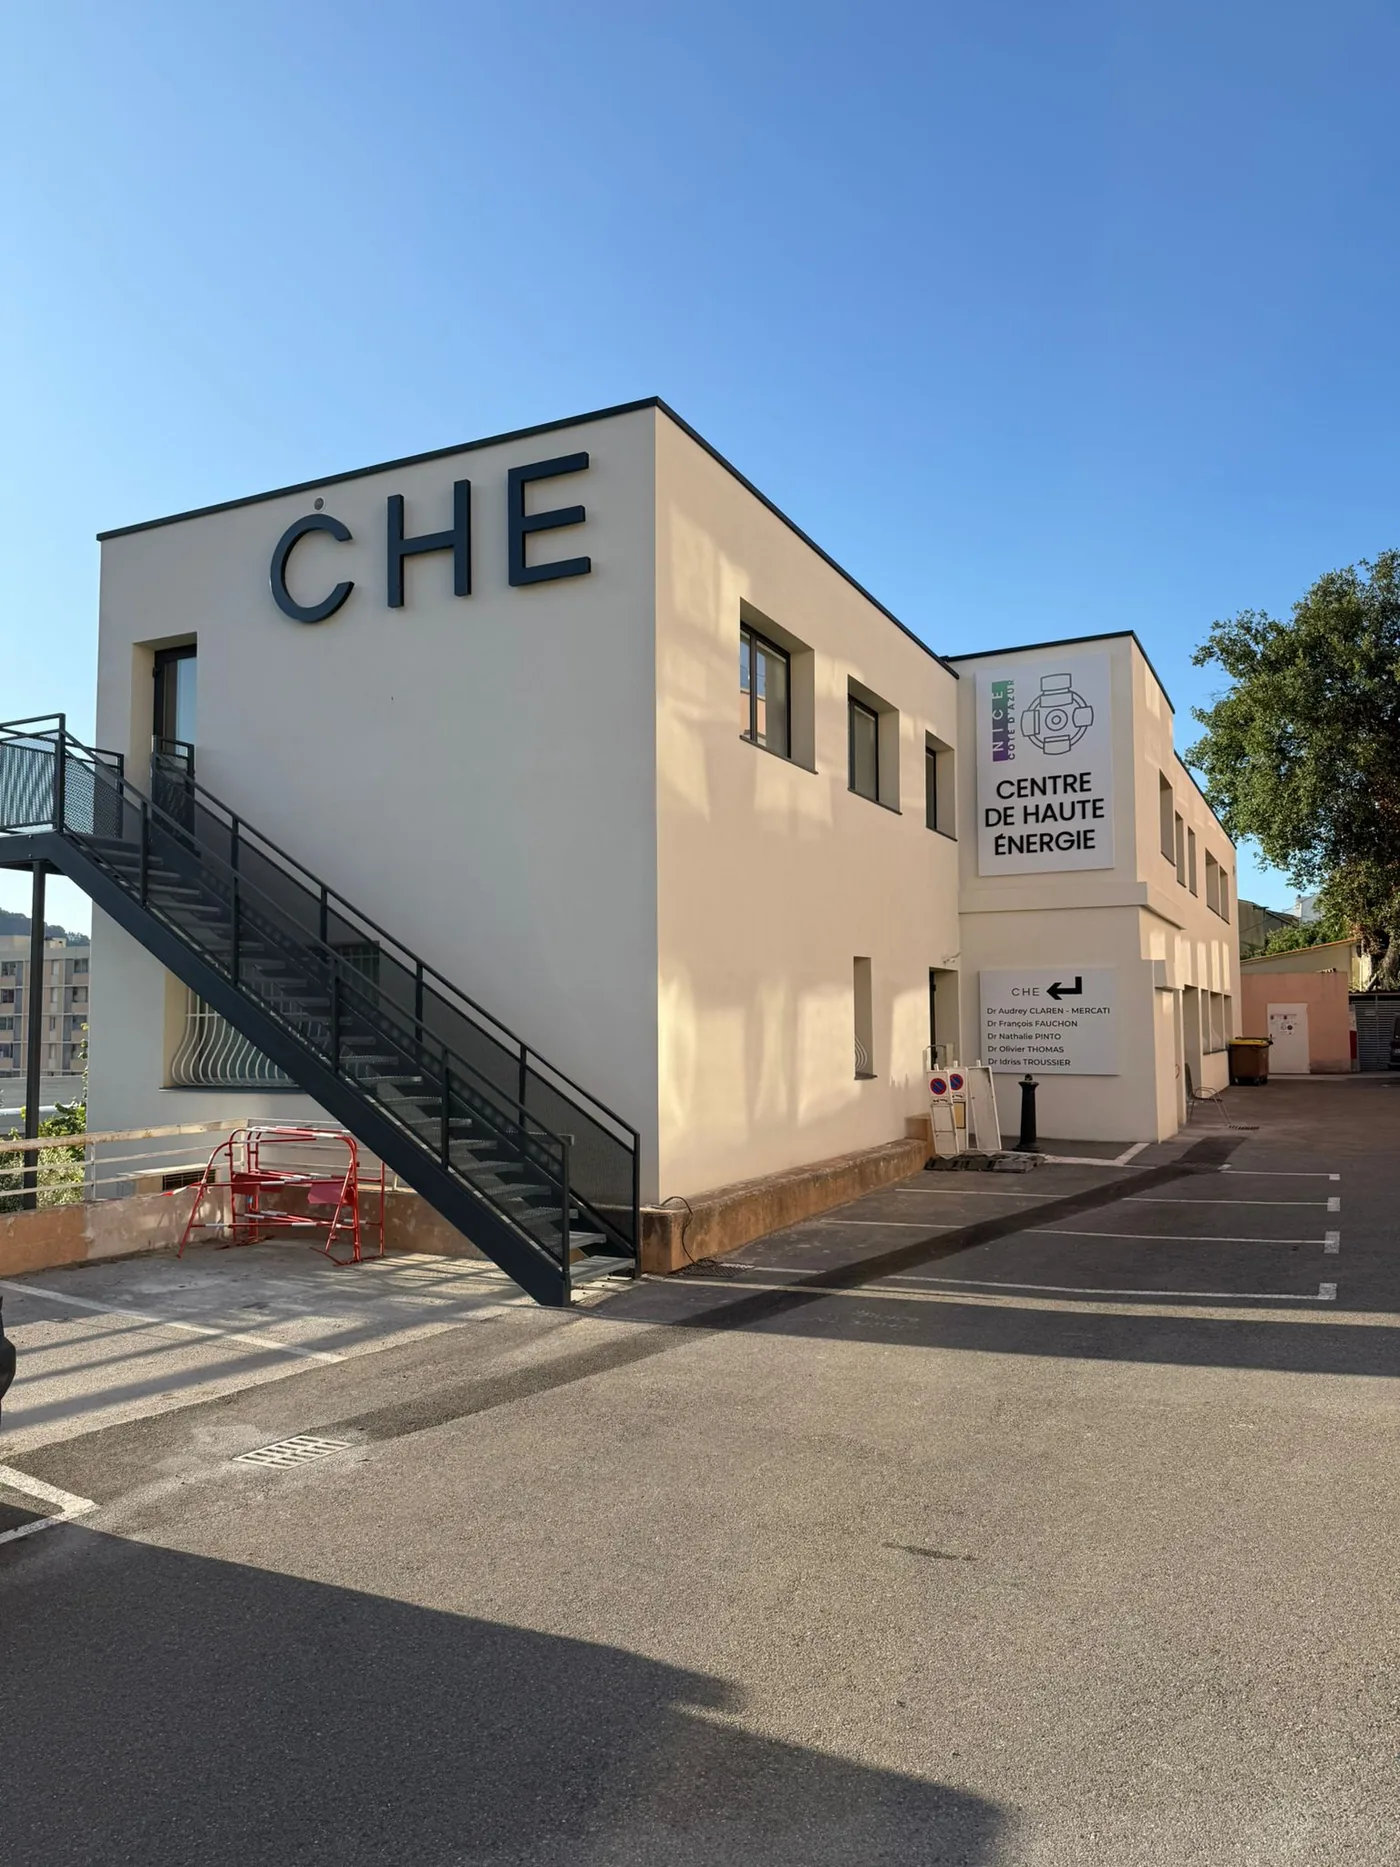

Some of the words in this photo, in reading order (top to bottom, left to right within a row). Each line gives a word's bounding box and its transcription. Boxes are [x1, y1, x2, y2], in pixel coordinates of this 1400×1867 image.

[270, 452, 591, 623] CHE
[1007, 680, 1015, 723] D'AZUR
[992, 691, 1004, 751] NICE
[996, 772, 1092, 800] CENTRE
[985, 806, 1015, 827] DE
[1024, 798, 1105, 824] HAUTE
[994, 829, 1096, 855] ÉNERGIE
[1012, 988, 1040, 996] CHE
[999, 1008, 1027, 1016] Audrey
[999, 1020, 1033, 1028] François
